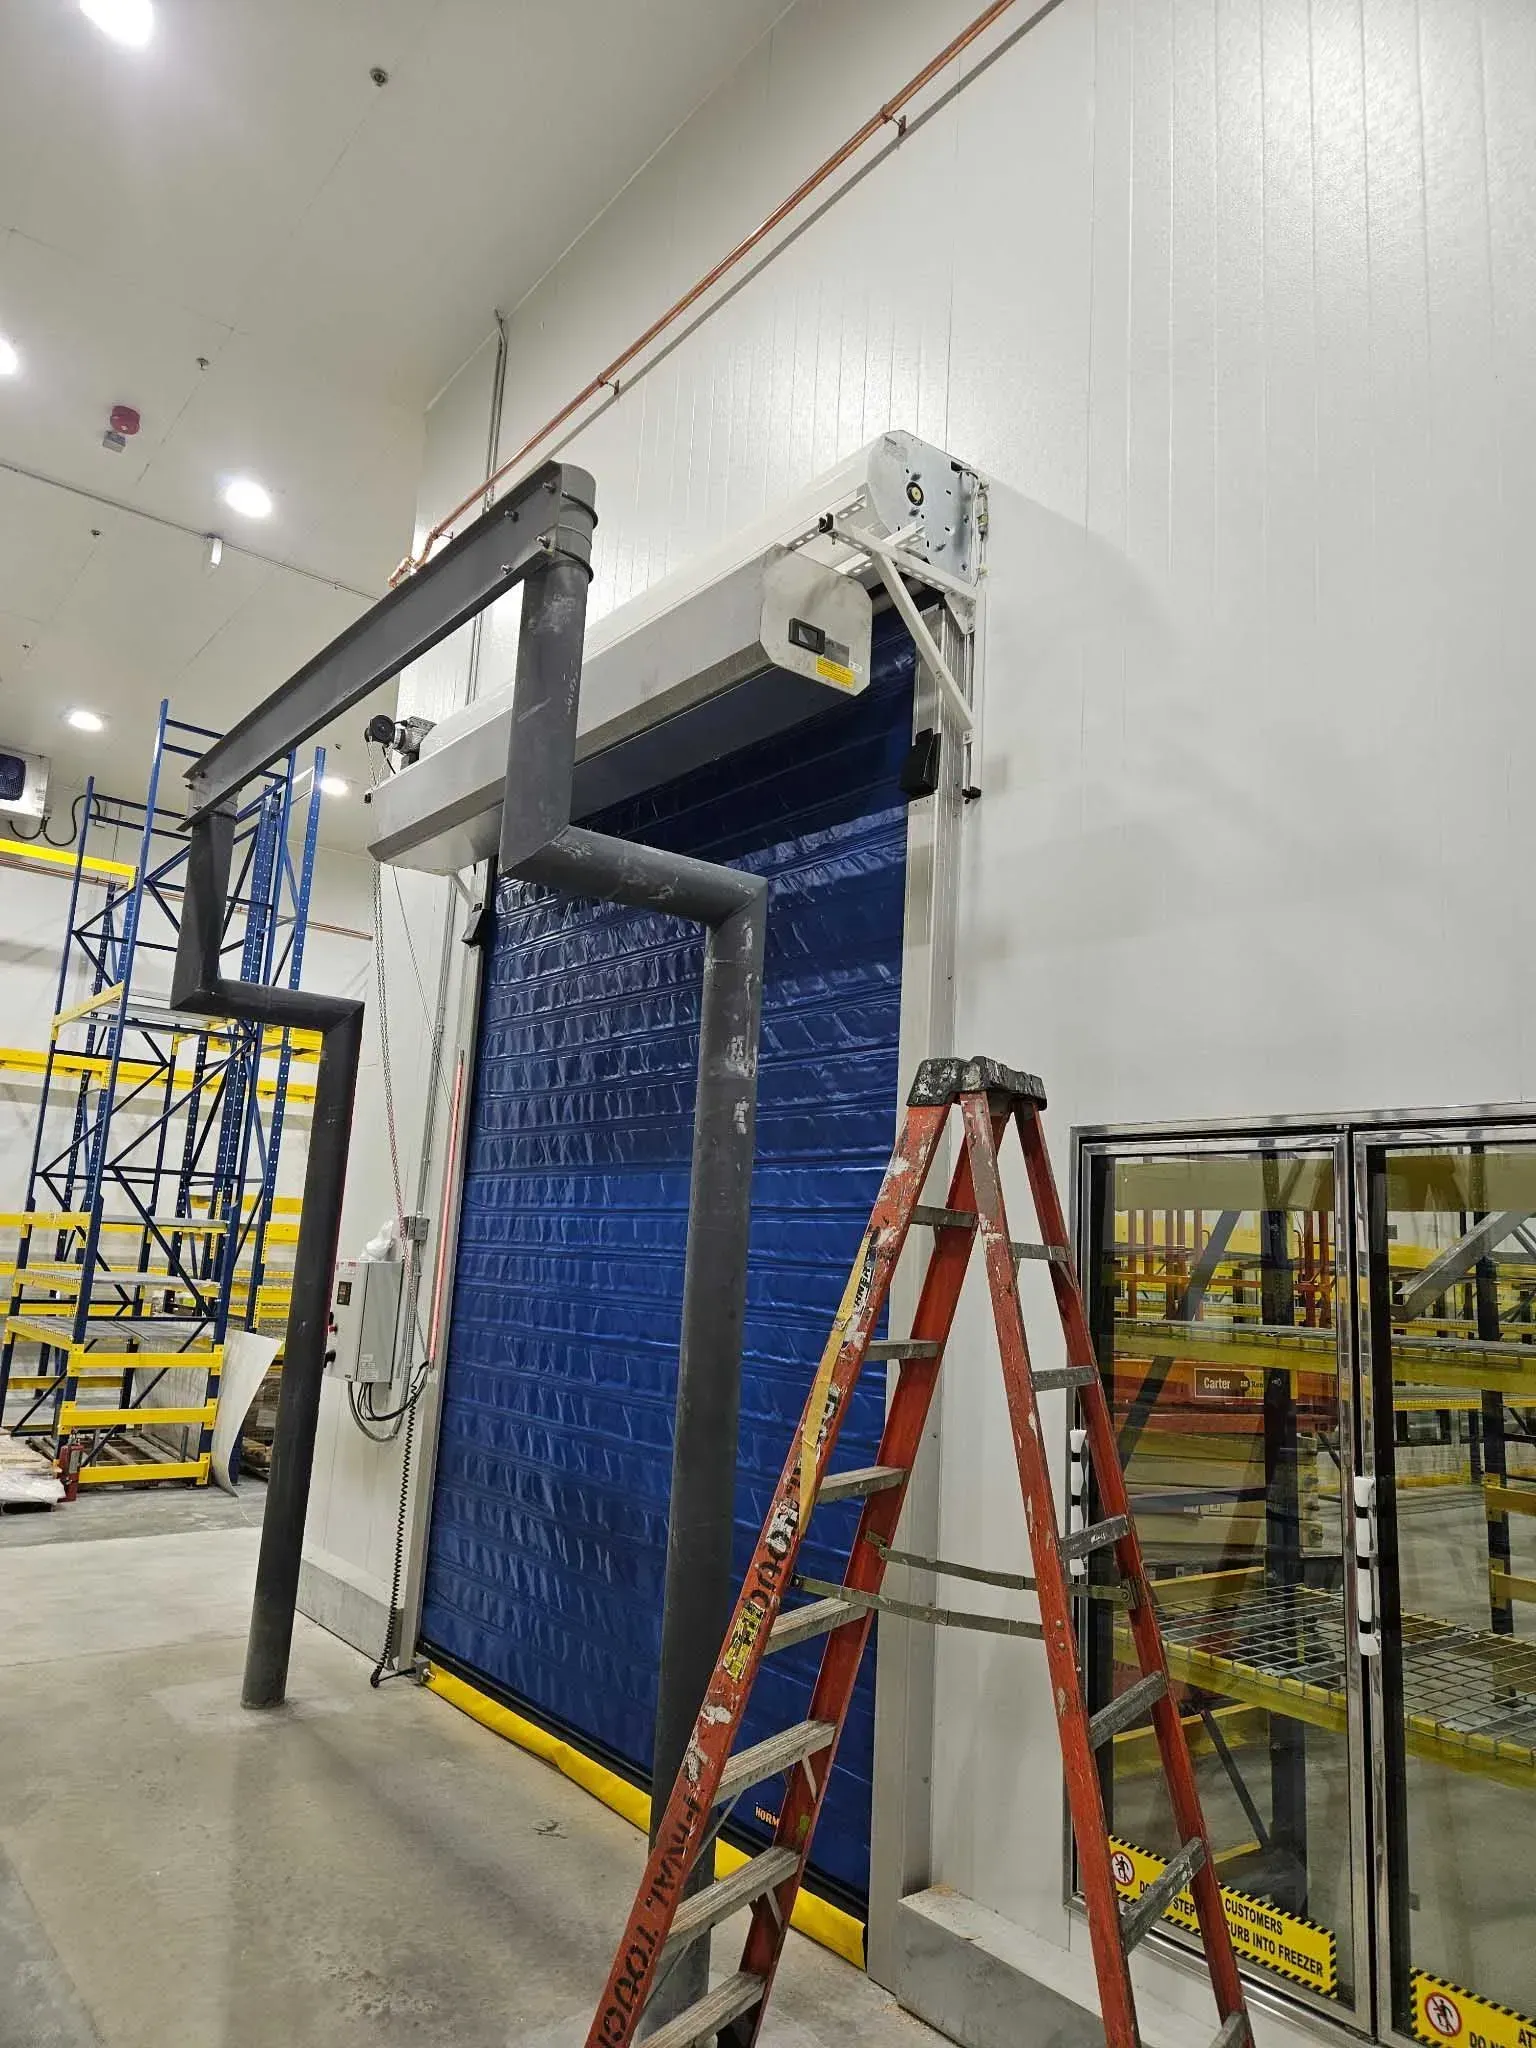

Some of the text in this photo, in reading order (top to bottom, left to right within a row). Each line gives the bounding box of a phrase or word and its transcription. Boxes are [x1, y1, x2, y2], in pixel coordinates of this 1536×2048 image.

[1204, 1376, 1231, 1390] Carter
[1172, 1896, 1196, 1917] STEP
[1228, 1921, 1250, 1943] URB
[1253, 1932, 1276, 1955] INTO
[1278, 1943, 1324, 1978] FREEZER
[1225, 1898, 1283, 1936] CUSTOMERS
[598, 1924, 660, 2048] TOUC
